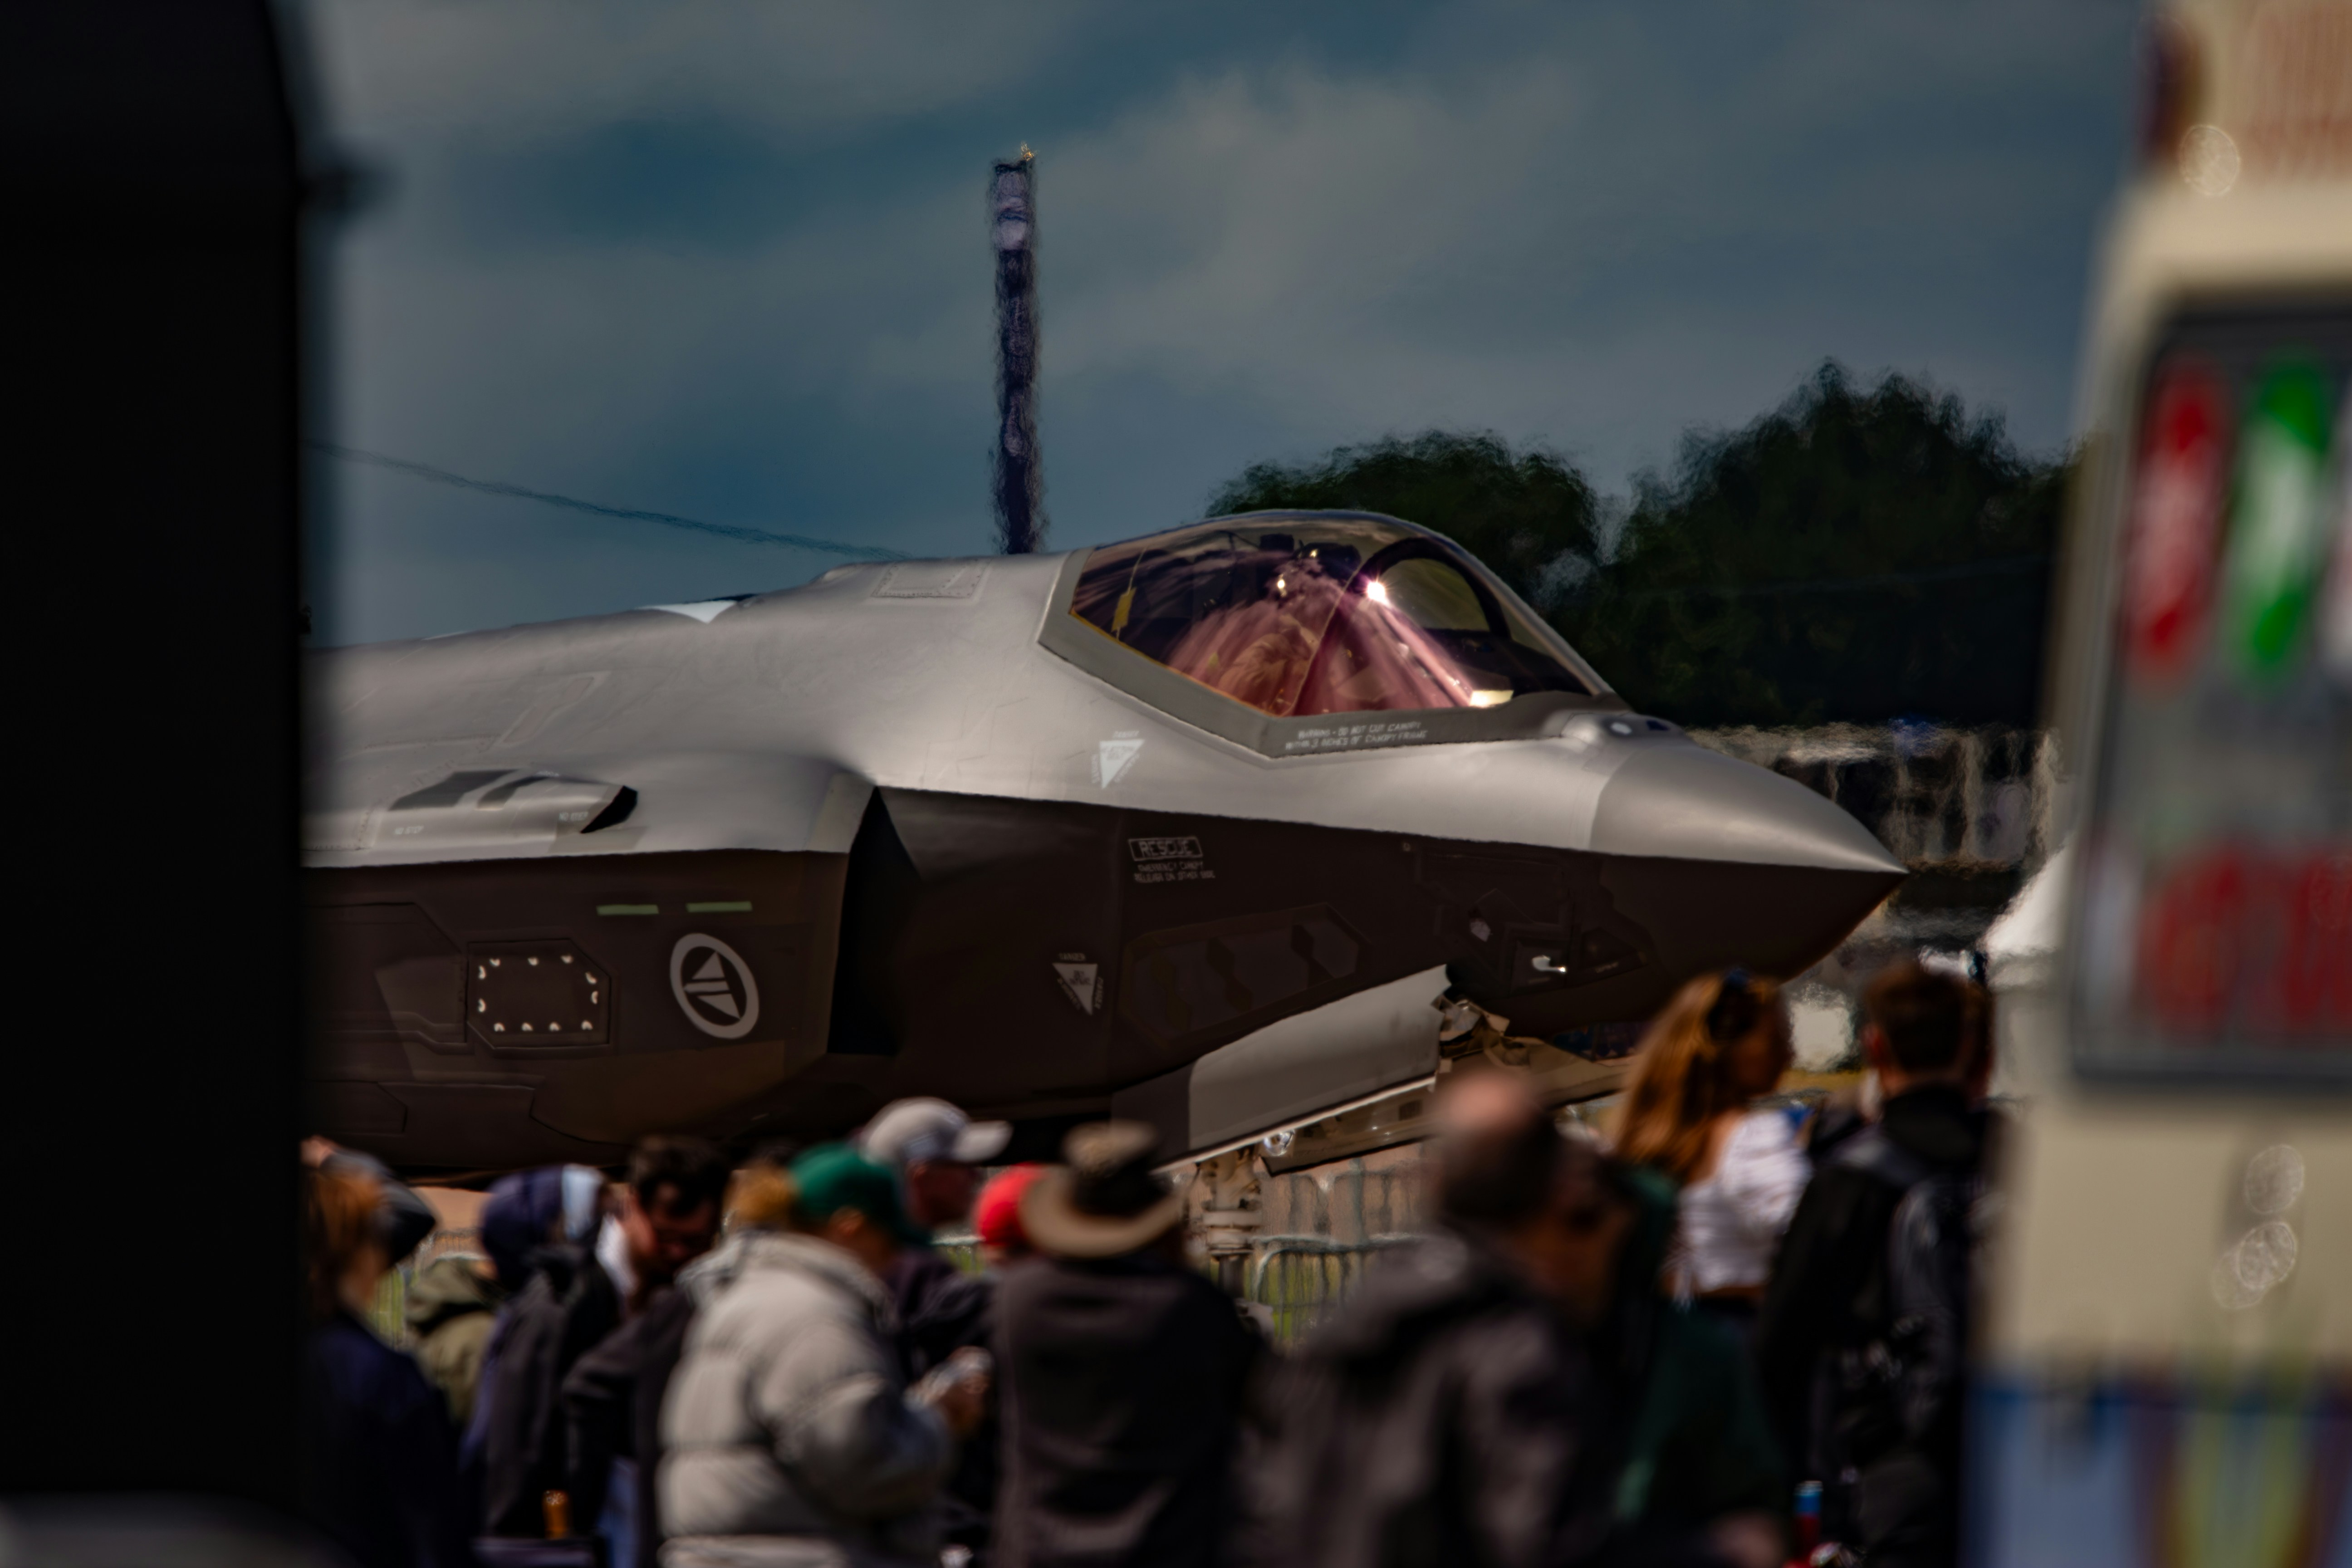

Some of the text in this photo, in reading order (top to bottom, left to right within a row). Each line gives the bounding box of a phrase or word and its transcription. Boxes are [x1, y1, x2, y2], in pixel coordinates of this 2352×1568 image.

[1369, 724, 1385, 733] CUT
[1365, 733, 1396, 743] CANOPY
[1138, 839, 1193, 857] RESCUE
